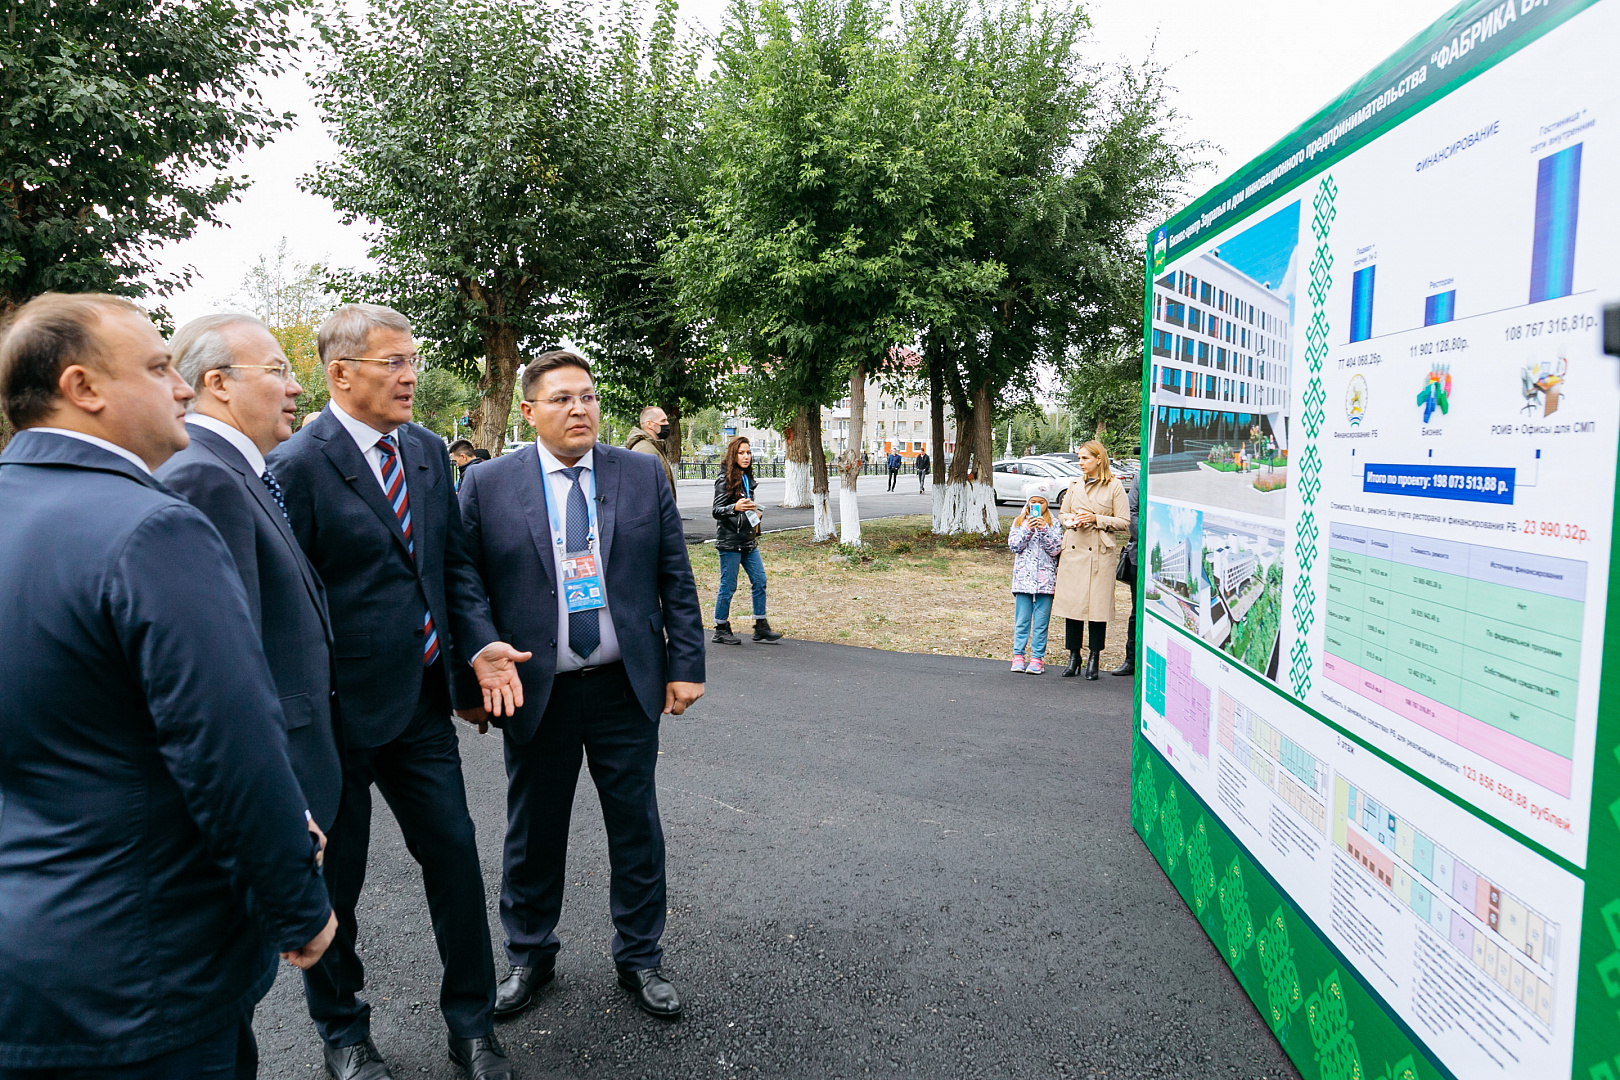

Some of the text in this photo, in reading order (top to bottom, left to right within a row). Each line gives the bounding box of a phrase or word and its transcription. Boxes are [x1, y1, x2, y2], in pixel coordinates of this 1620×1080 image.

[1200, 201, 1227, 228] Зауралья
[1231, 189, 1245, 211] дом
[1245, 148, 1305, 199] инновационного
[1305, 65, 1428, 161] предпринимательства
[1415, 119, 1500, 173] ФИНАНСИРОВАНИЕ
[1505, 313, 1599, 341] 108 767 316,81р.
[1409, 344, 1418, 358] 11
[1419, 341, 1434, 356] 902
[1421, 427, 1443, 437] Бизнес
[1521, 423, 1553, 437] Офисы
[1573, 421, 1596, 434] СМП
[1366, 470, 1509, 496] Итого по проекту: 198 073 513,88 р.
[1447, 515, 1506, 531] финансирования
[1506, 521, 1518, 533] РБ
[1523, 519, 1537, 535] 23
[1539, 521, 1592, 545] 990,32р.
[1462, 764, 1477, 782] 123
[1479, 773, 1494, 792] 856
[1497, 782, 1528, 810] 528,88
